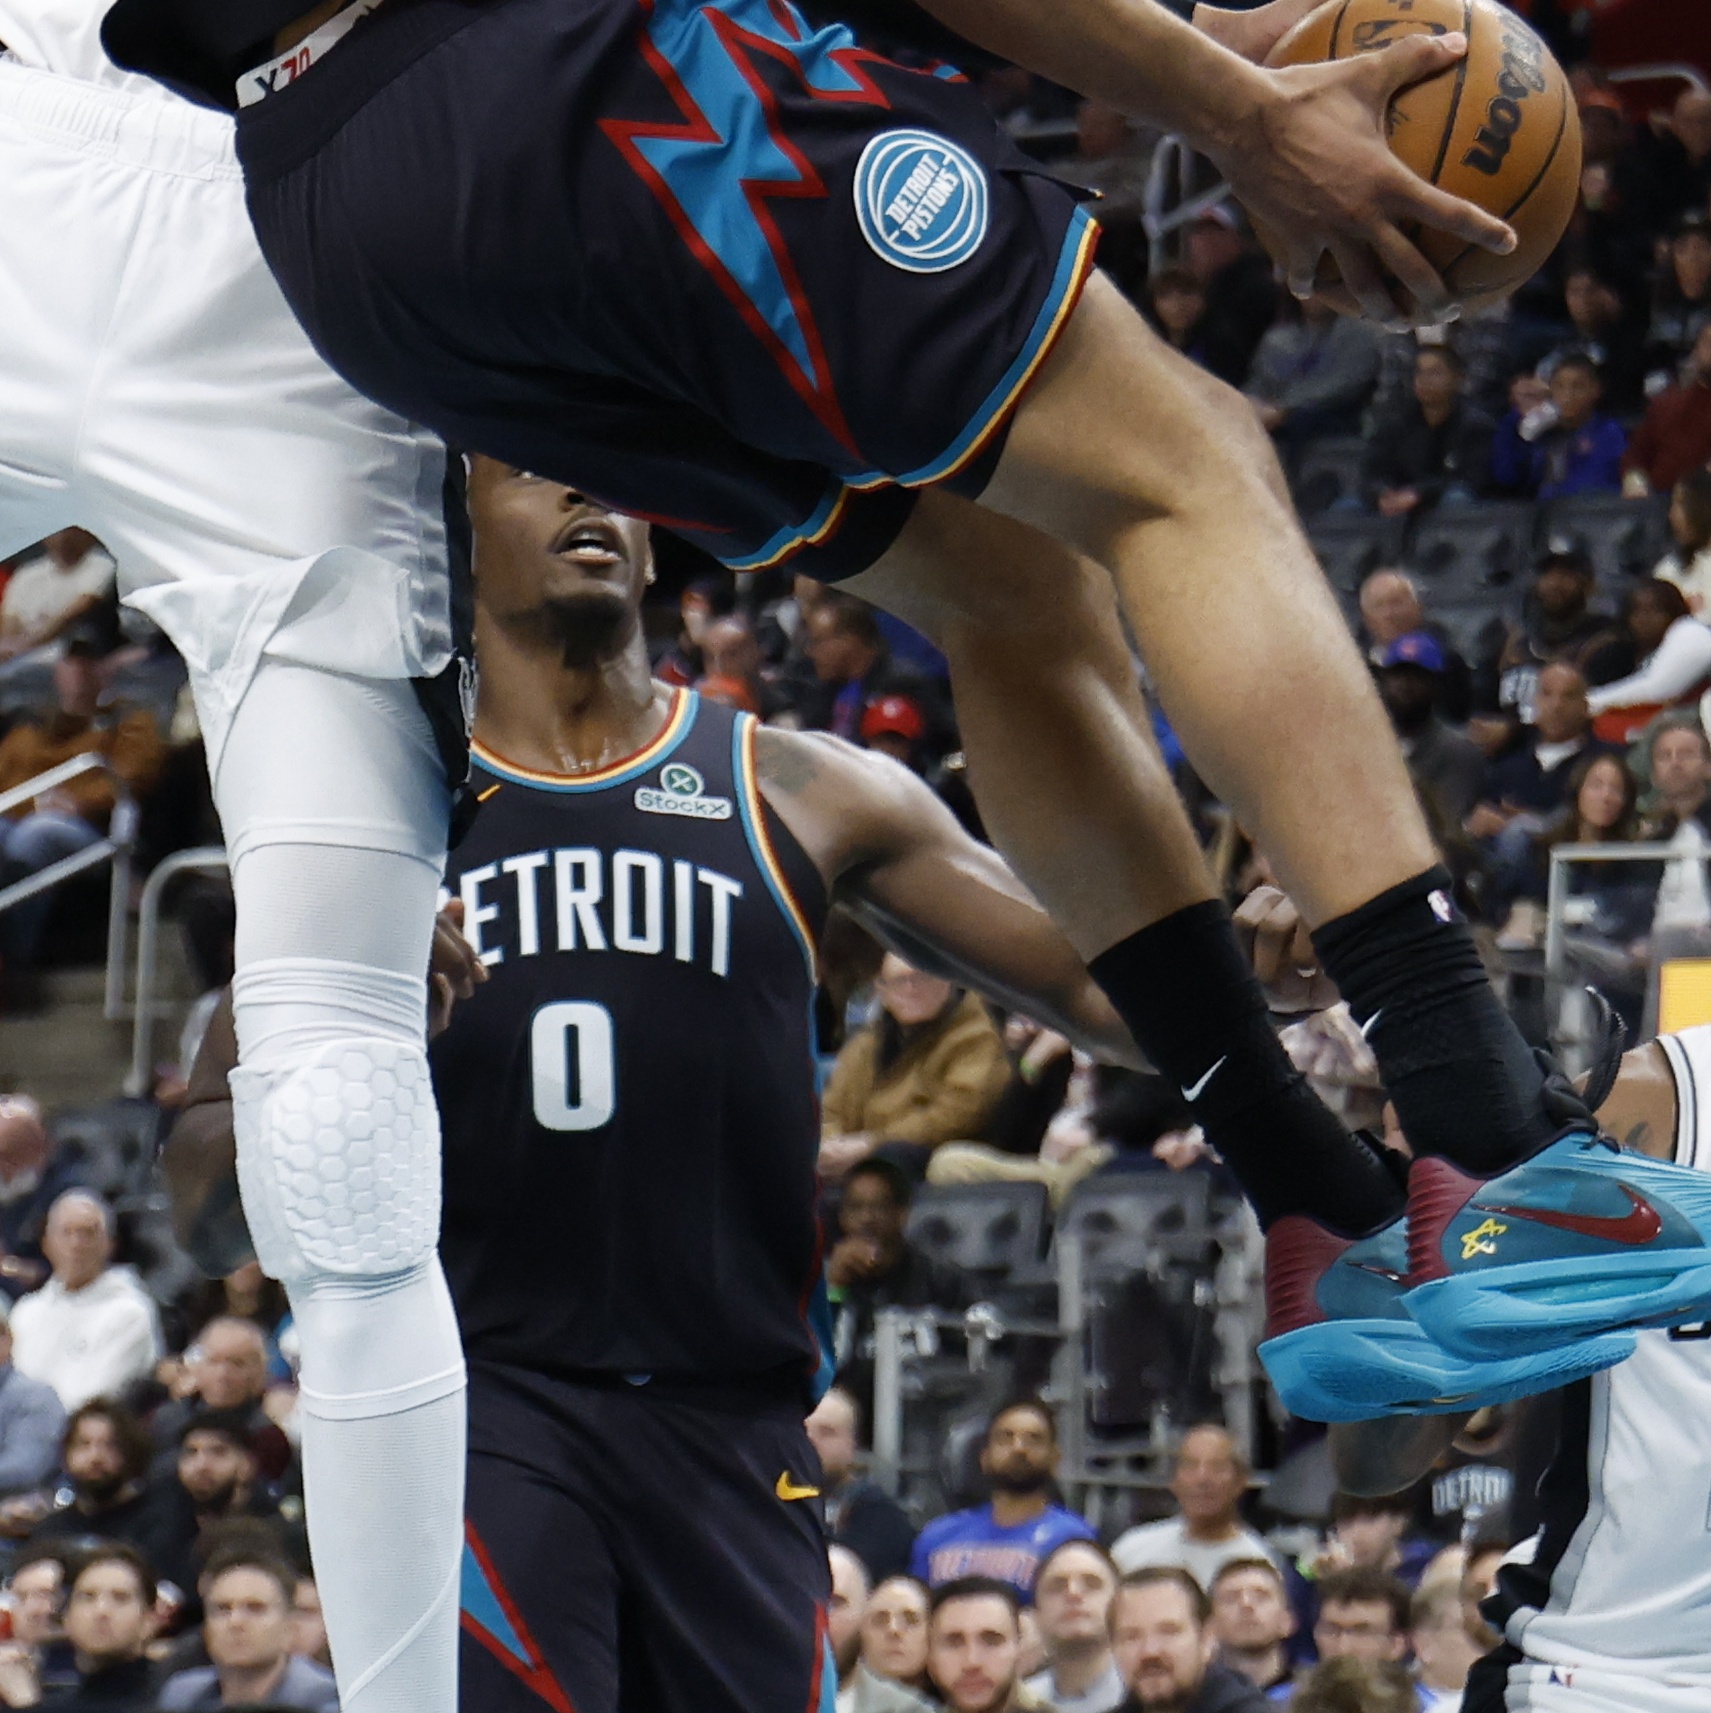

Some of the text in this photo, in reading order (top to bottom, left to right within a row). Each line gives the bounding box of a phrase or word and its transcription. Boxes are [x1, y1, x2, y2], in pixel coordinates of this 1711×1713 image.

[884, 152, 940, 225] DETROIT
[901, 167, 960, 241] PISTONS
[639, 791, 726, 817] StockX
[437, 845, 744, 978] ETROIT
[530, 999, 616, 1132] 0
